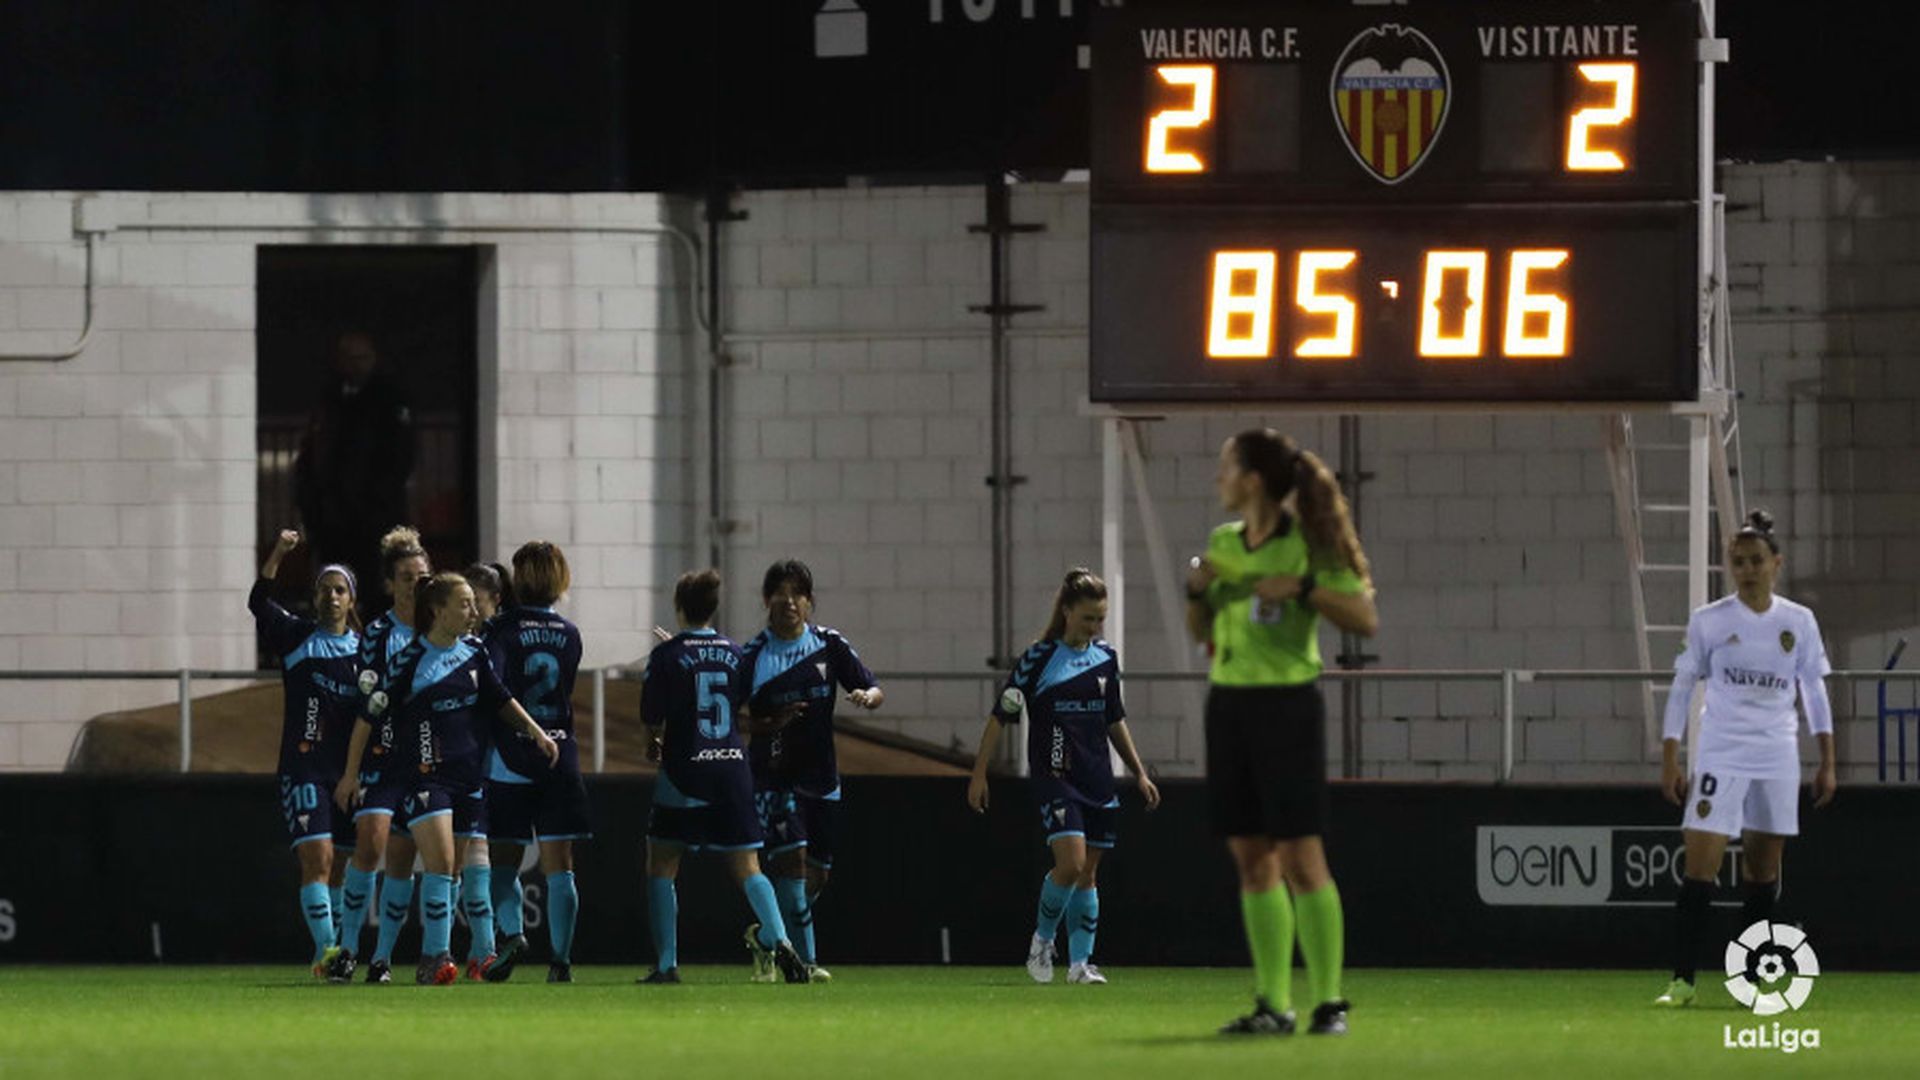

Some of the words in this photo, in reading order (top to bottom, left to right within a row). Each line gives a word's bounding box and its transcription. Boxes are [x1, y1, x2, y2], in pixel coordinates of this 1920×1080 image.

[1141, 28, 1252, 59] VALENCIA
[1261, 27, 1301, 58] C.F.
[1478, 24, 1639, 57] VISITANTE
[1344, 78, 1410, 89] VALENCIA
[1146, 65, 1216, 173] 2
[1566, 62, 1636, 171] 2
[519, 629, 568, 650] HITOMI
[523, 650, 561, 720] 2
[1723, 667, 1789, 690] Navarro
[304, 696, 319, 741] nexus
[694, 671, 732, 740] 5
[421, 720, 434, 765] nexus
[291, 782, 317, 811] 10
[1490, 832, 1597, 887] beIN
